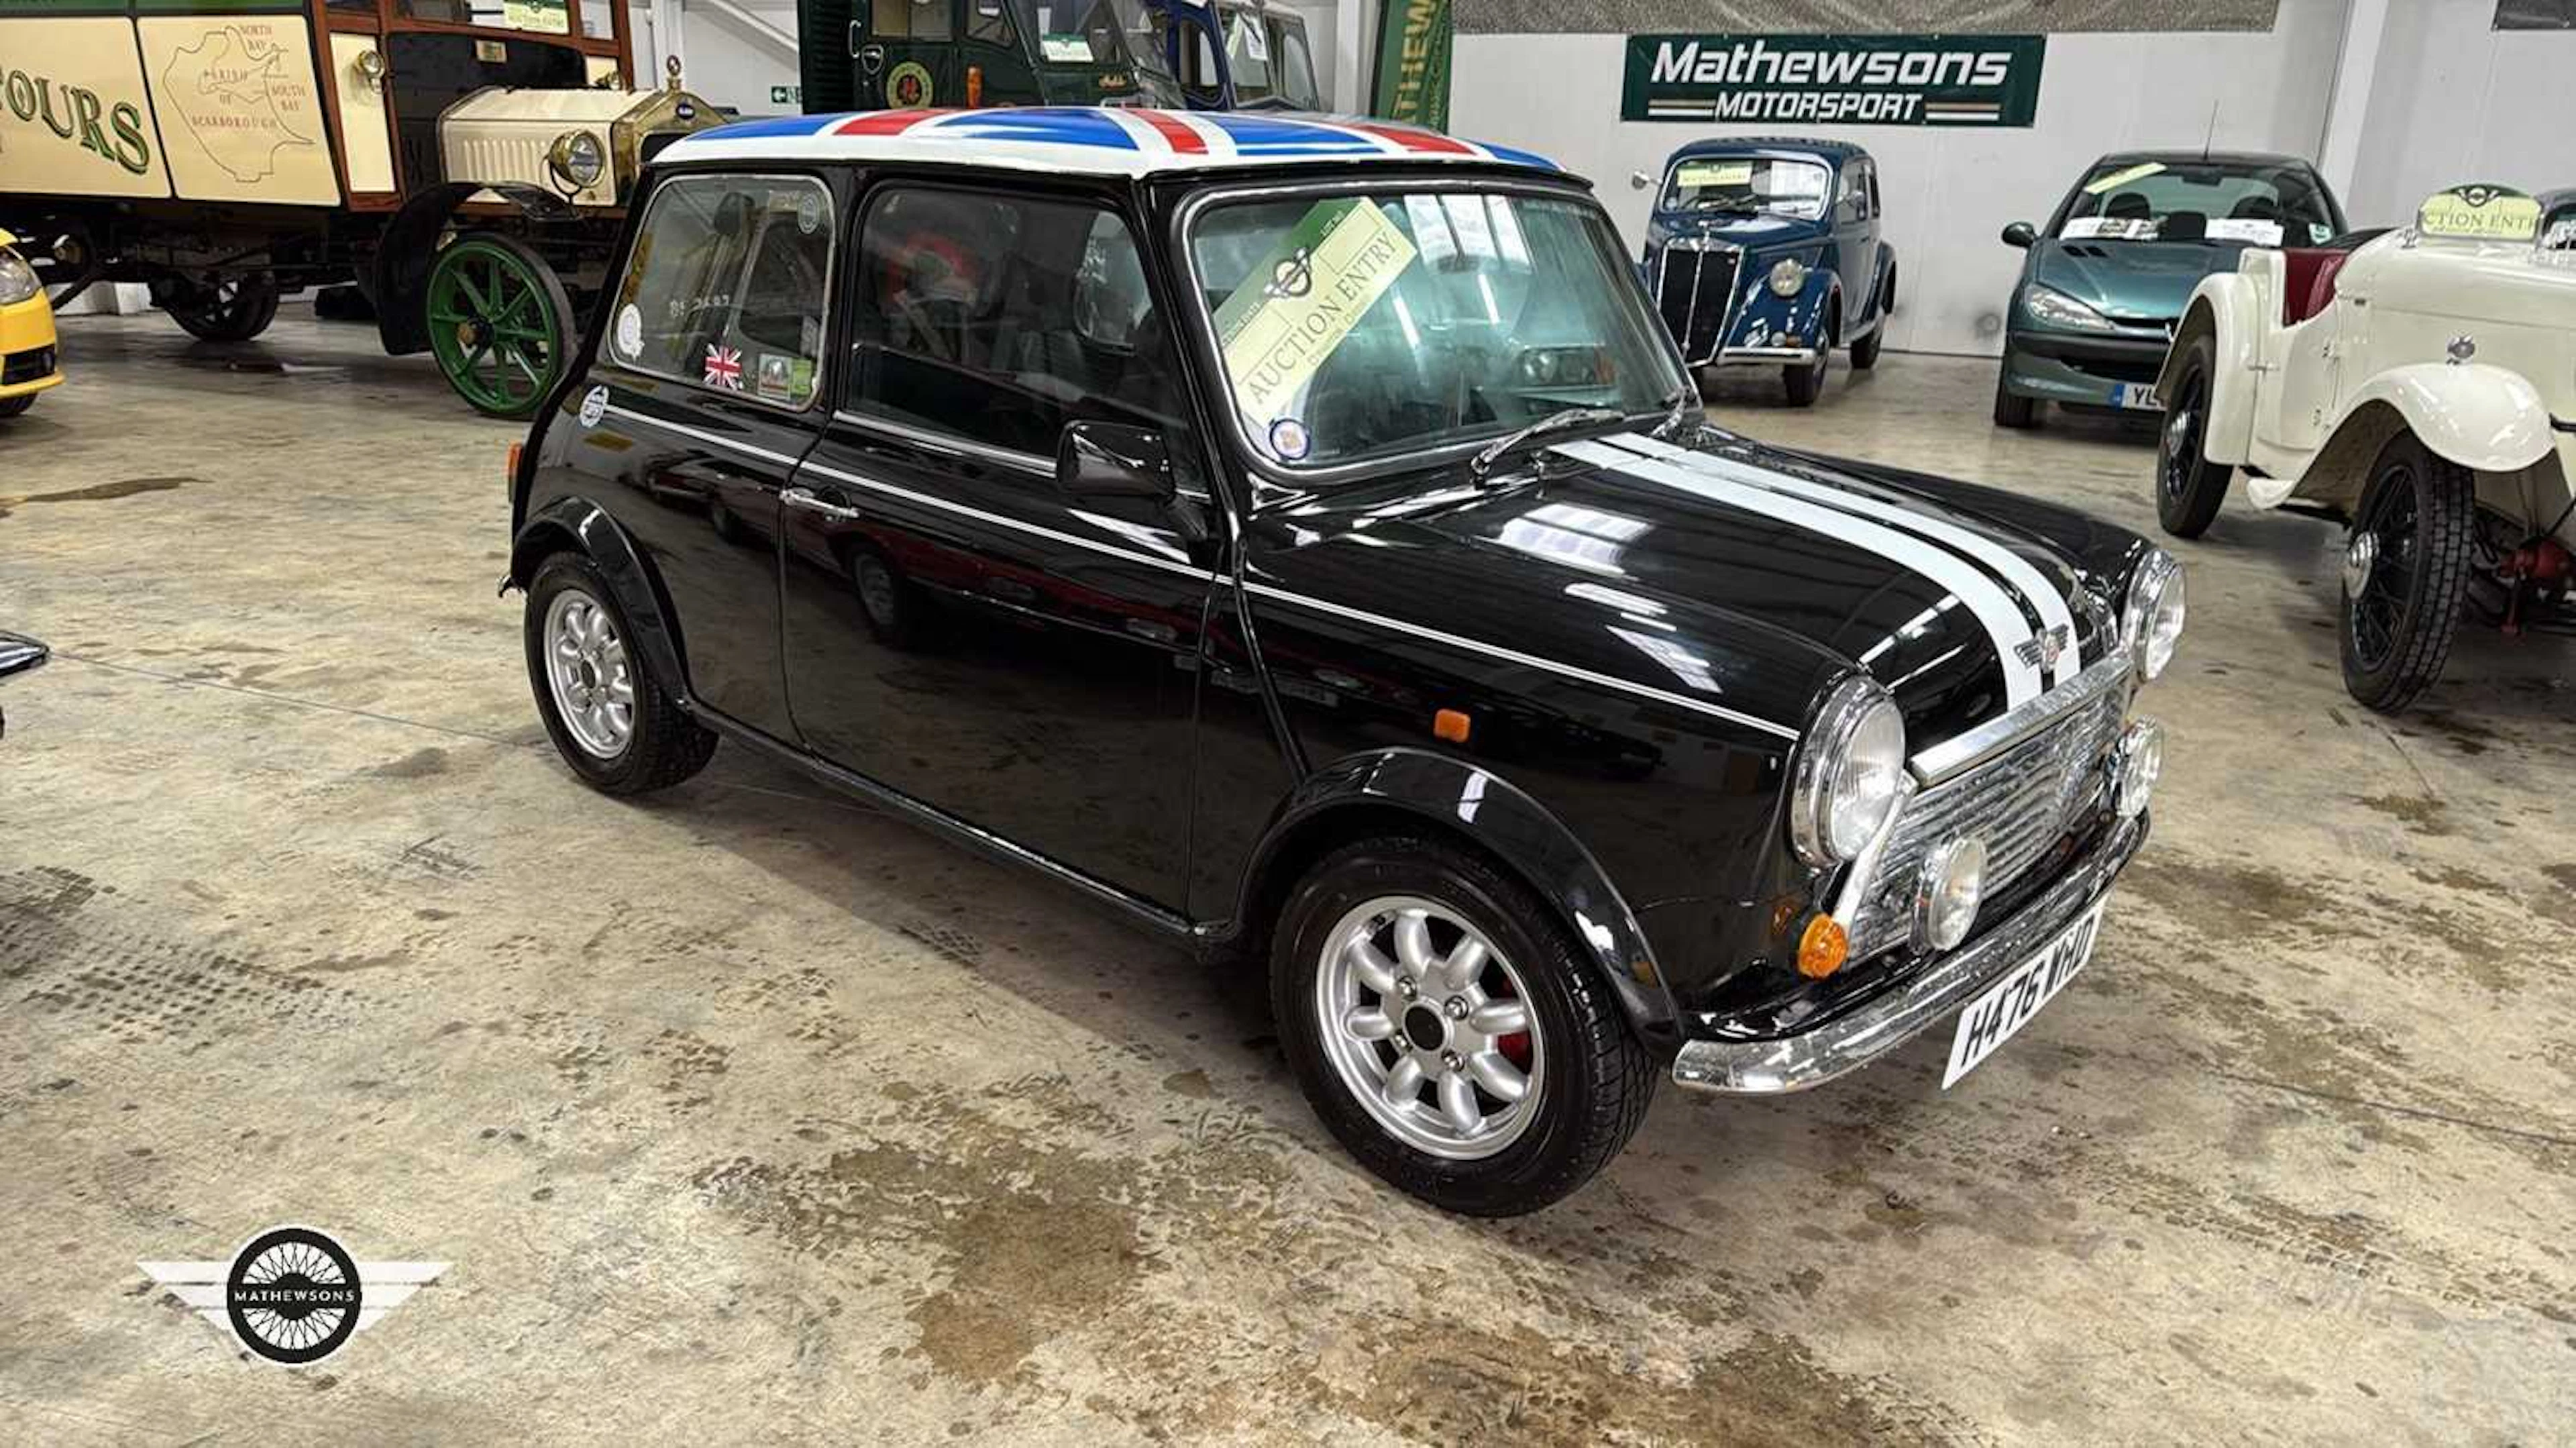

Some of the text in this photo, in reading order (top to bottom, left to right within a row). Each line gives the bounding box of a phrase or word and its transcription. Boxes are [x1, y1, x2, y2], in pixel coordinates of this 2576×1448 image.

[1393, 0, 1437, 123] THEW
[1650, 40, 2012, 85] Mathewsons
[1715, 92, 1922, 120] MOTORSPORT
[0, 64, 149, 175] OURS
[1248, 295, 1342, 405] AUCTION
[1335, 231, 1397, 301] ENTRY
[1961, 960, 2045, 1067] H476
